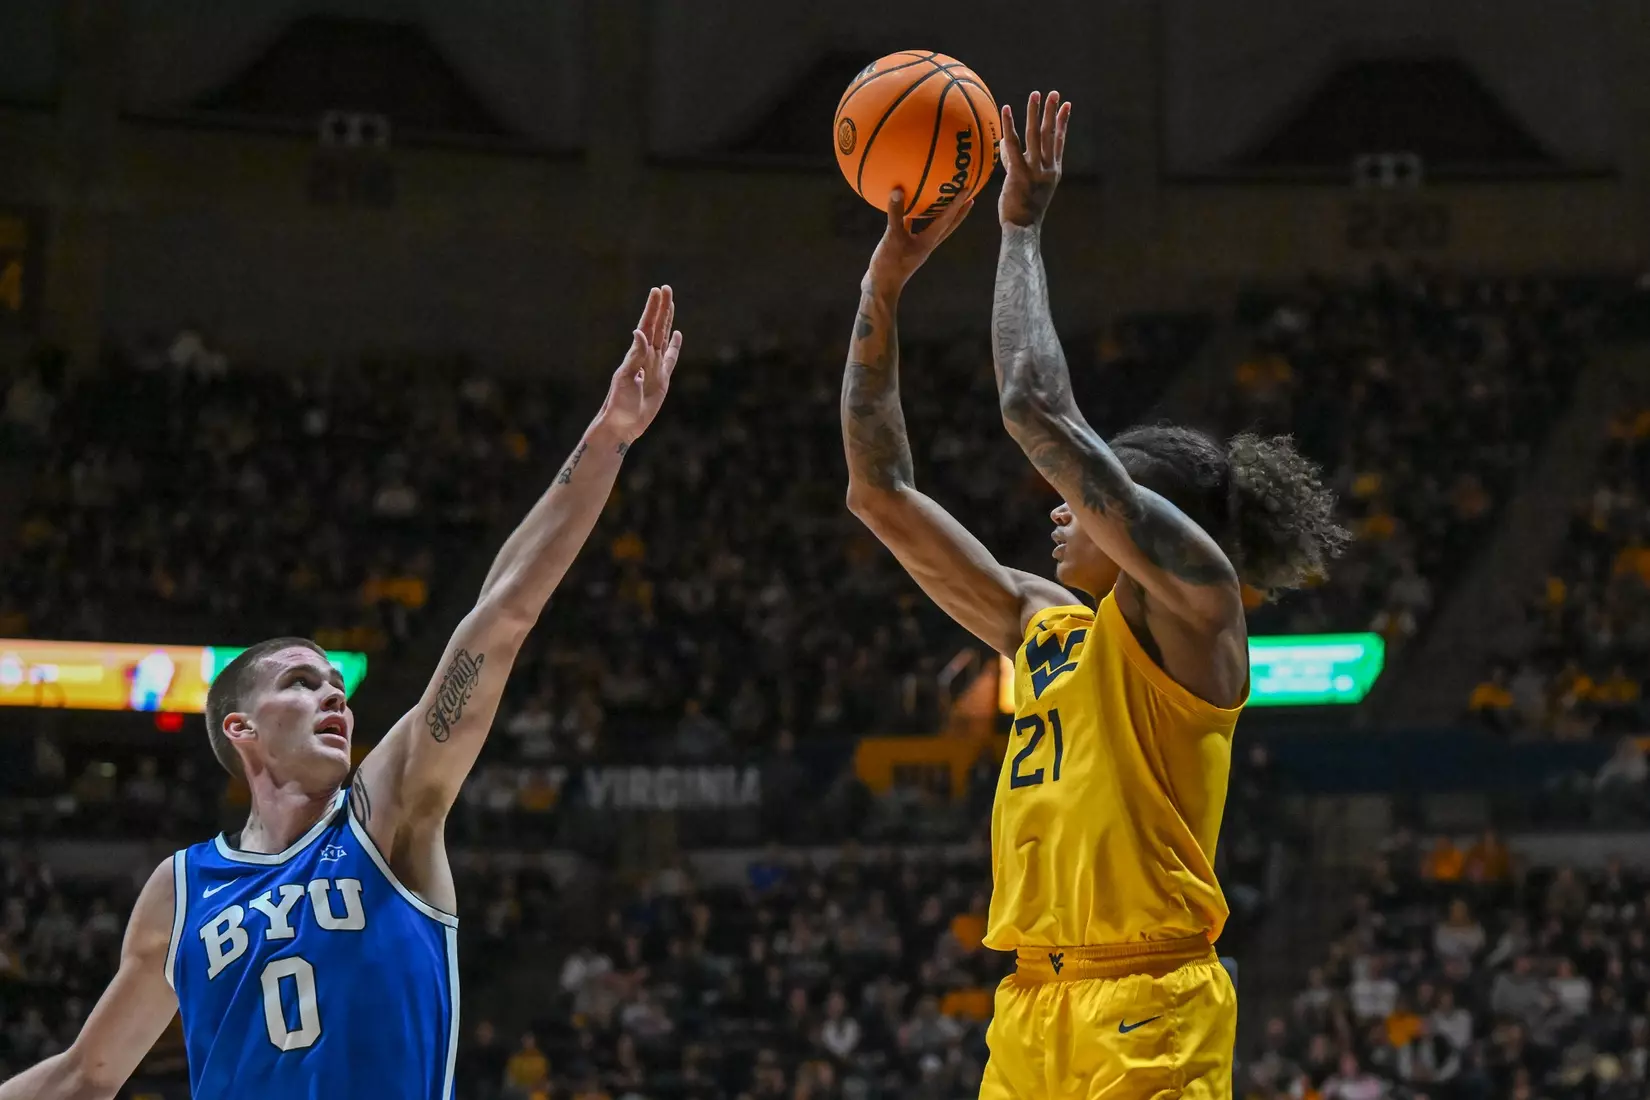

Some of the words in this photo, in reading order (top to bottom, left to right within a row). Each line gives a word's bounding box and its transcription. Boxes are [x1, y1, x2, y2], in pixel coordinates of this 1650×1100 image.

[583, 764, 760, 809] VIRGINIA
[1010, 708, 1063, 790] 21
[199, 878, 366, 981] BYU
[260, 955, 322, 1052] 0
